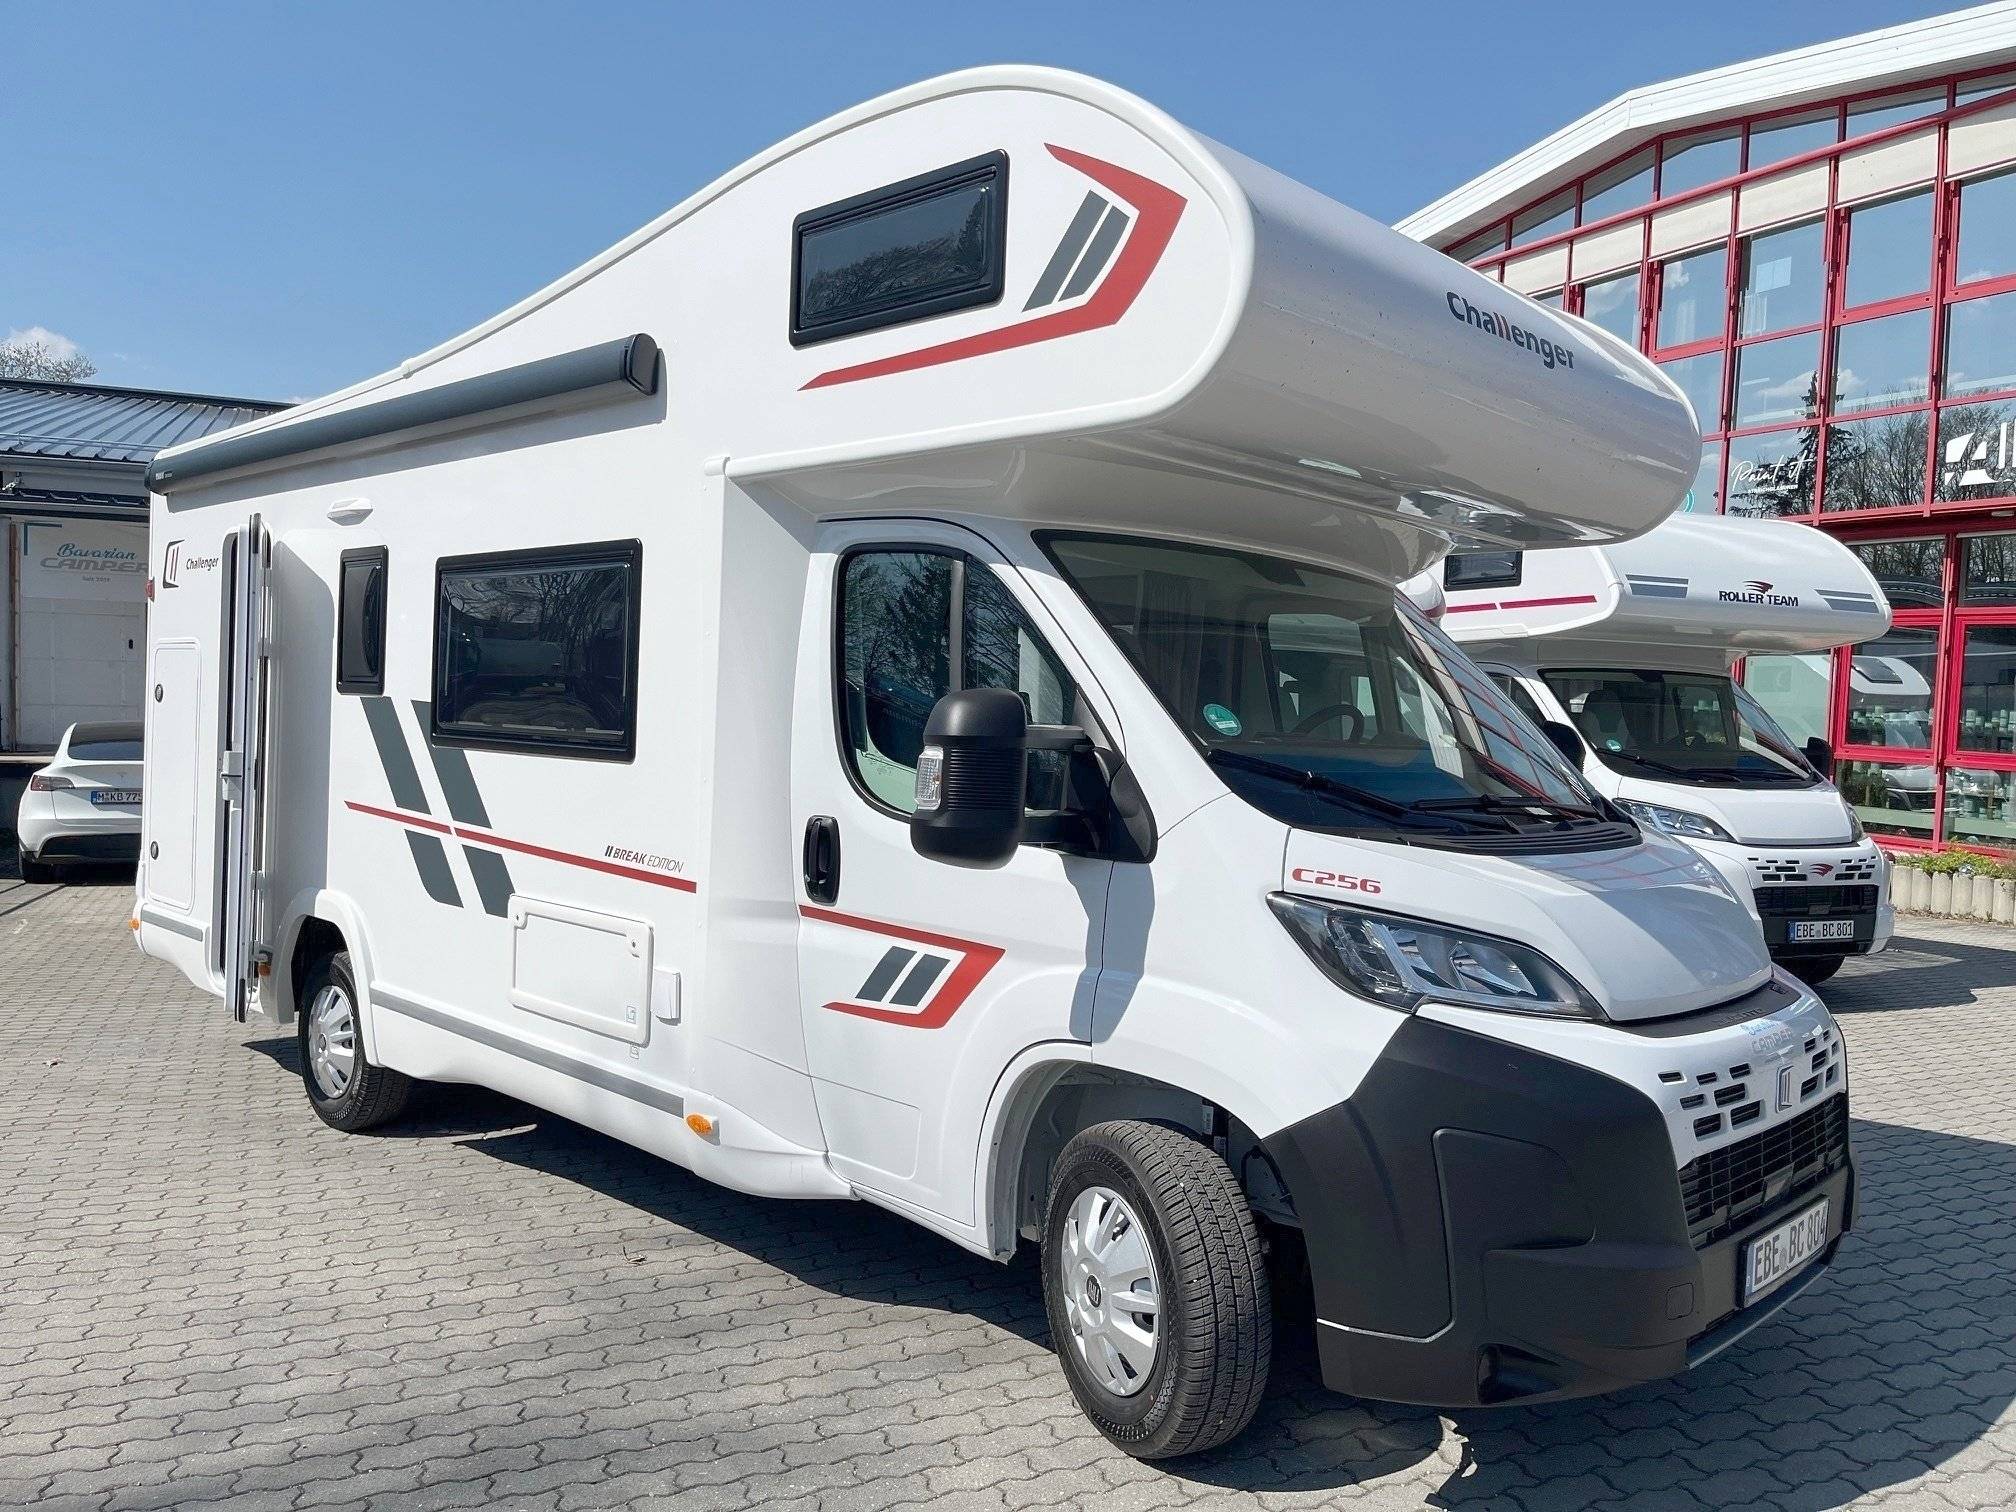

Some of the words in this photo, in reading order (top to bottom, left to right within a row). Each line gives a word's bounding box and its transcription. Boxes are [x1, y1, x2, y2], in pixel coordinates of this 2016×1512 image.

[1446, 291, 1574, 370] Challenger
[1731, 454, 1785, 492] Paint
[1788, 449, 1814, 484] it
[57, 543, 136, 561] Bavarian
[185, 557, 219, 571] Challenger
[1718, 590, 1764, 604] ROLLER
[1766, 594, 1799, 607] TEAM
[613, 847, 648, 865] BREAK
[646, 854, 684, 873] EDITION
[1292, 868, 1381, 894] C256
[1796, 924, 1815, 938] EBE
[1822, 923, 1835, 937] BC
[1836, 922, 1853, 936] 801
[1754, 1233, 1780, 1286] EBE
[1788, 1219, 1805, 1263] BC
